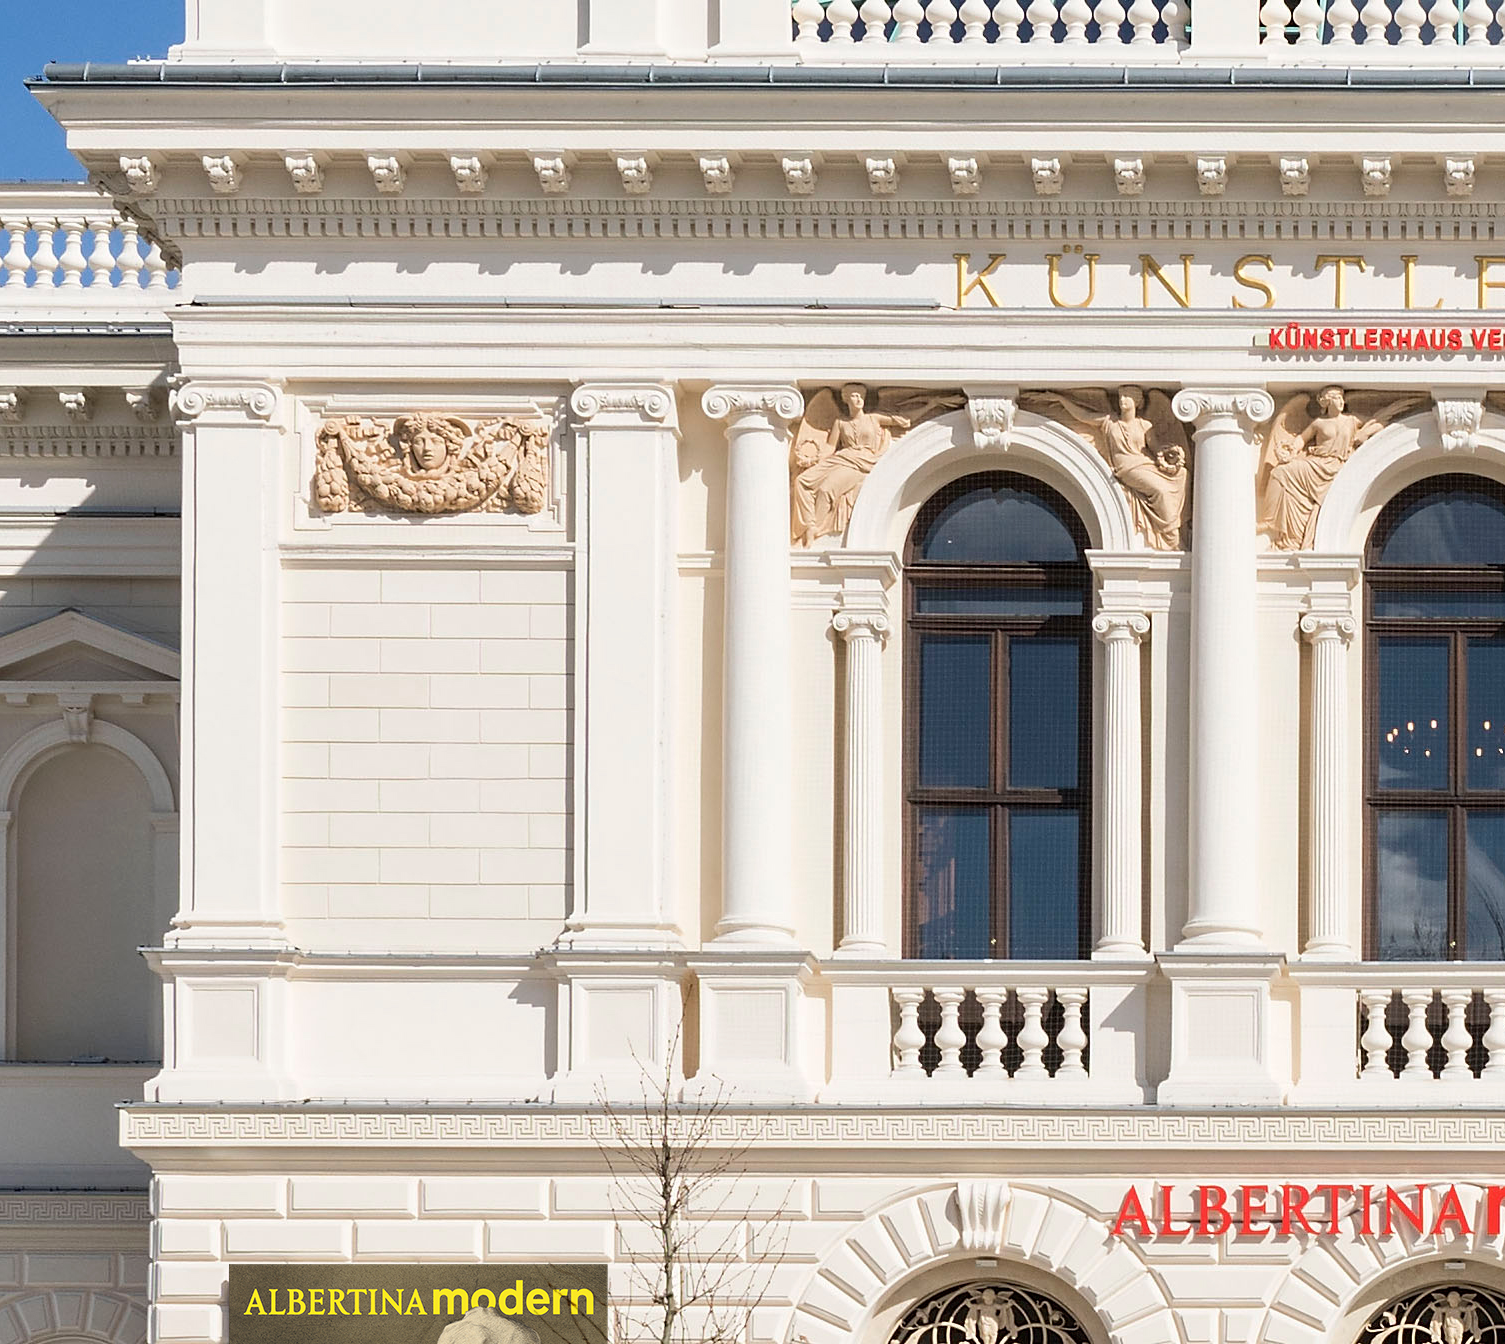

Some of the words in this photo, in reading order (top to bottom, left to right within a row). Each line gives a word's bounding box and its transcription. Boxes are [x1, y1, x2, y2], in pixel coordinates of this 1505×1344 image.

[1269, 322, 1464, 352] KÜNSTLERHAUS
[1109, 1184, 1476, 1237] ALBERTINA
[243, 1288, 428, 1316] ALBERTINA
[432, 1279, 594, 1316] modern
